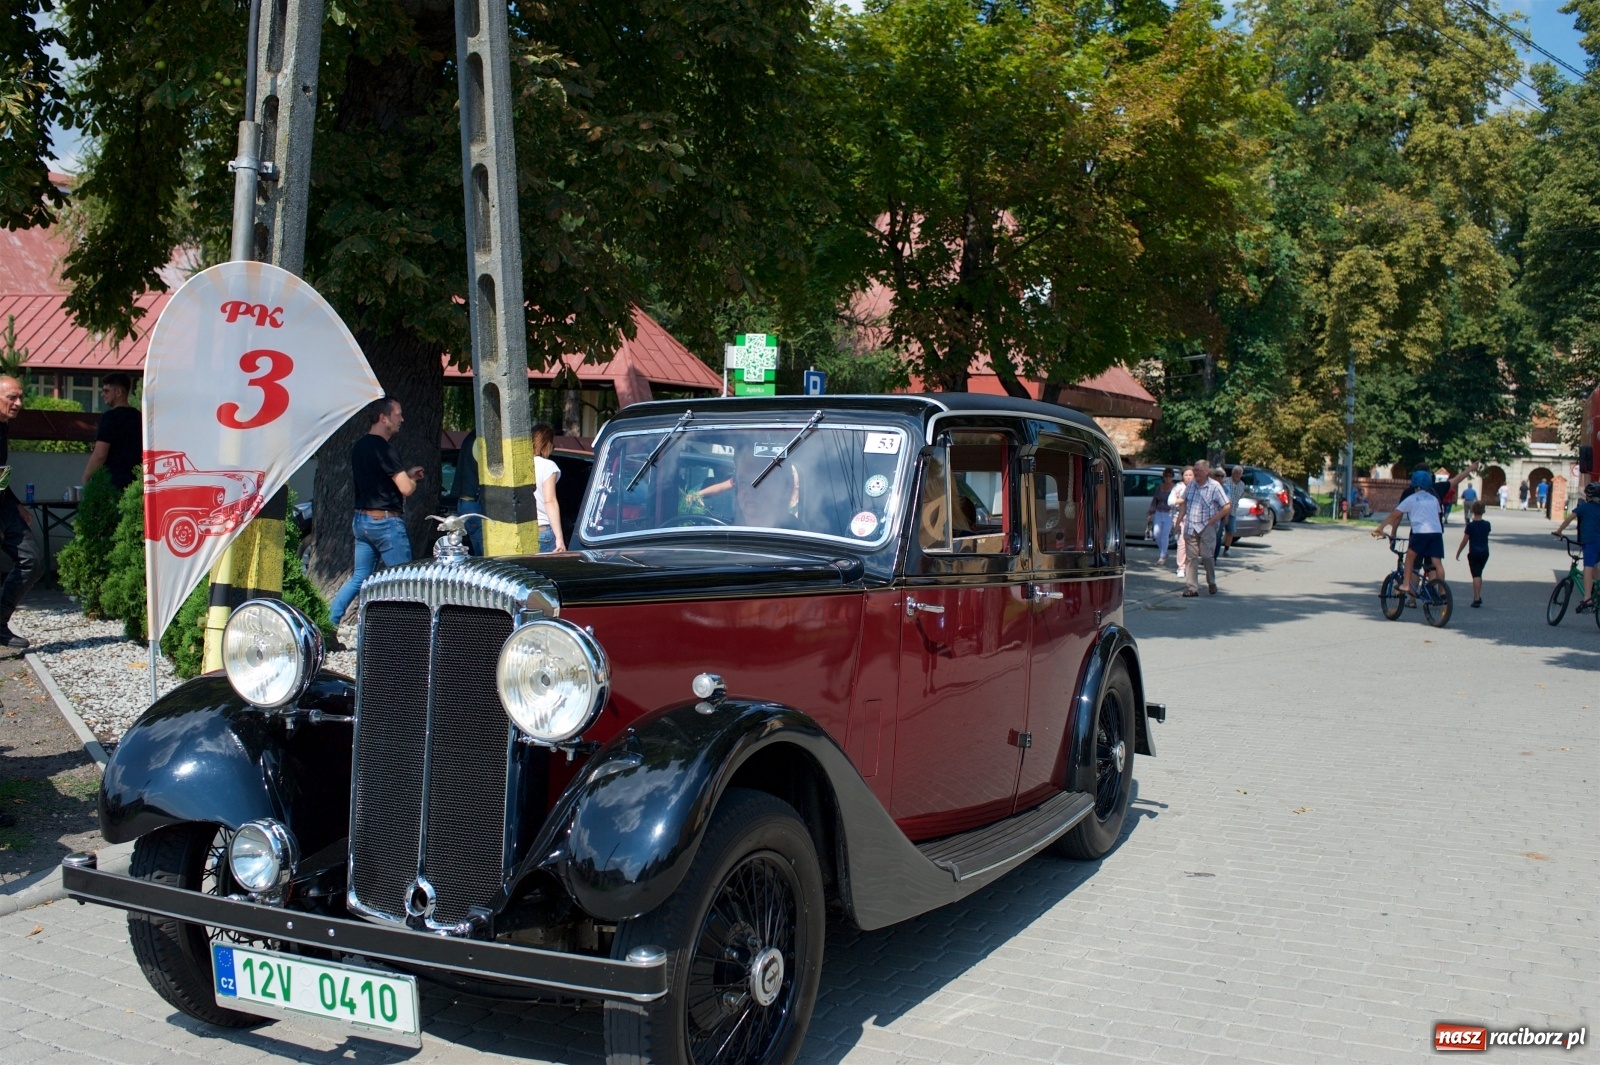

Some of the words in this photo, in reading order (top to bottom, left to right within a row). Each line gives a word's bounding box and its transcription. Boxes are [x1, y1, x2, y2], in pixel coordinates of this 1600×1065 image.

[220, 300, 284, 329] PK
[215, 348, 295, 430] 3
[877, 437, 895, 450] 53
[220, 976, 235, 990] CZ
[242, 957, 292, 1002] 12V
[318, 972, 398, 1023] 0410
